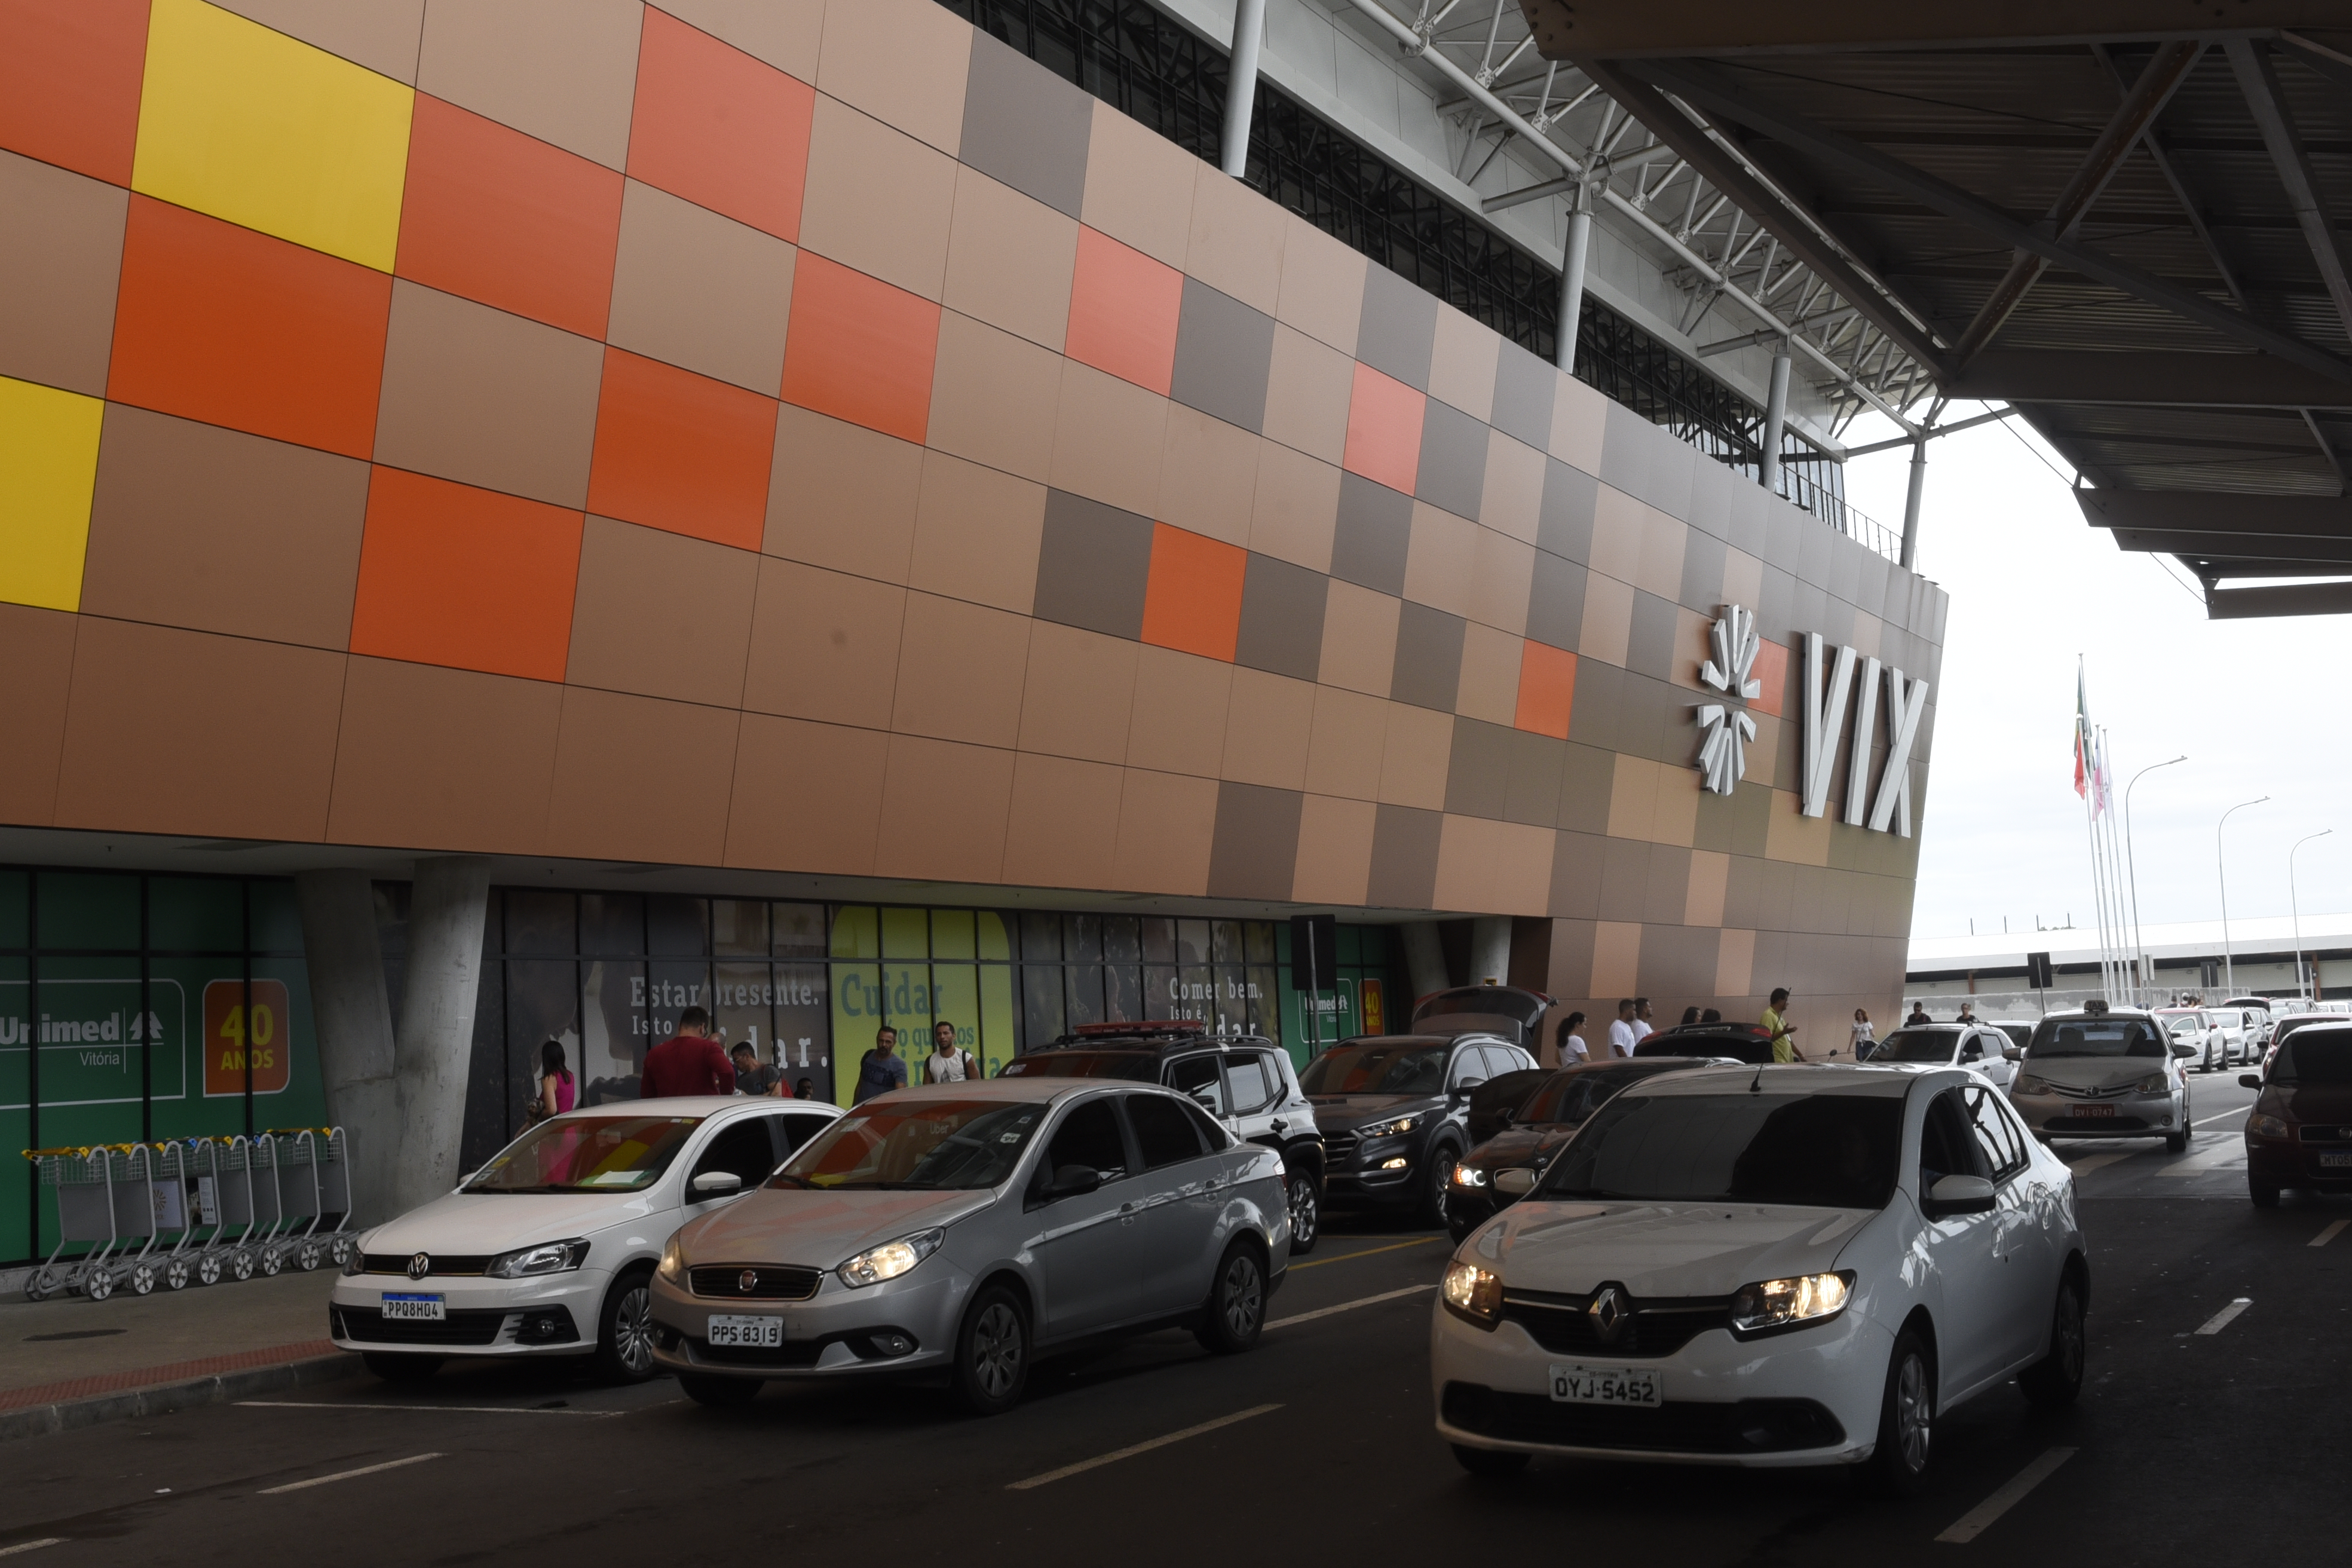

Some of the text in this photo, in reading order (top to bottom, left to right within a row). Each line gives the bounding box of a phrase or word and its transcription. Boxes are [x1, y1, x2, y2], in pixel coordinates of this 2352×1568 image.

[1803, 631, 1928, 838] VIX
[630, 976, 818, 1016] Estar presente.
[841, 971, 943, 1016] Cuidar
[1169, 976, 1263, 1000] Comer bem.
[1170, 1004, 1202, 1020] Isto é
[1365, 993, 1380, 1013] 40
[0, 1012, 120, 1045] Unimed
[220, 1004, 274, 1046] 40
[632, 1016, 672, 1034] Isto
[80, 1050, 120, 1067] Vitória
[220, 1049, 274, 1070] ANOS
[930, 1123, 950, 1135] Uber
[388, 1301, 438, 1317] PPQ8H04
